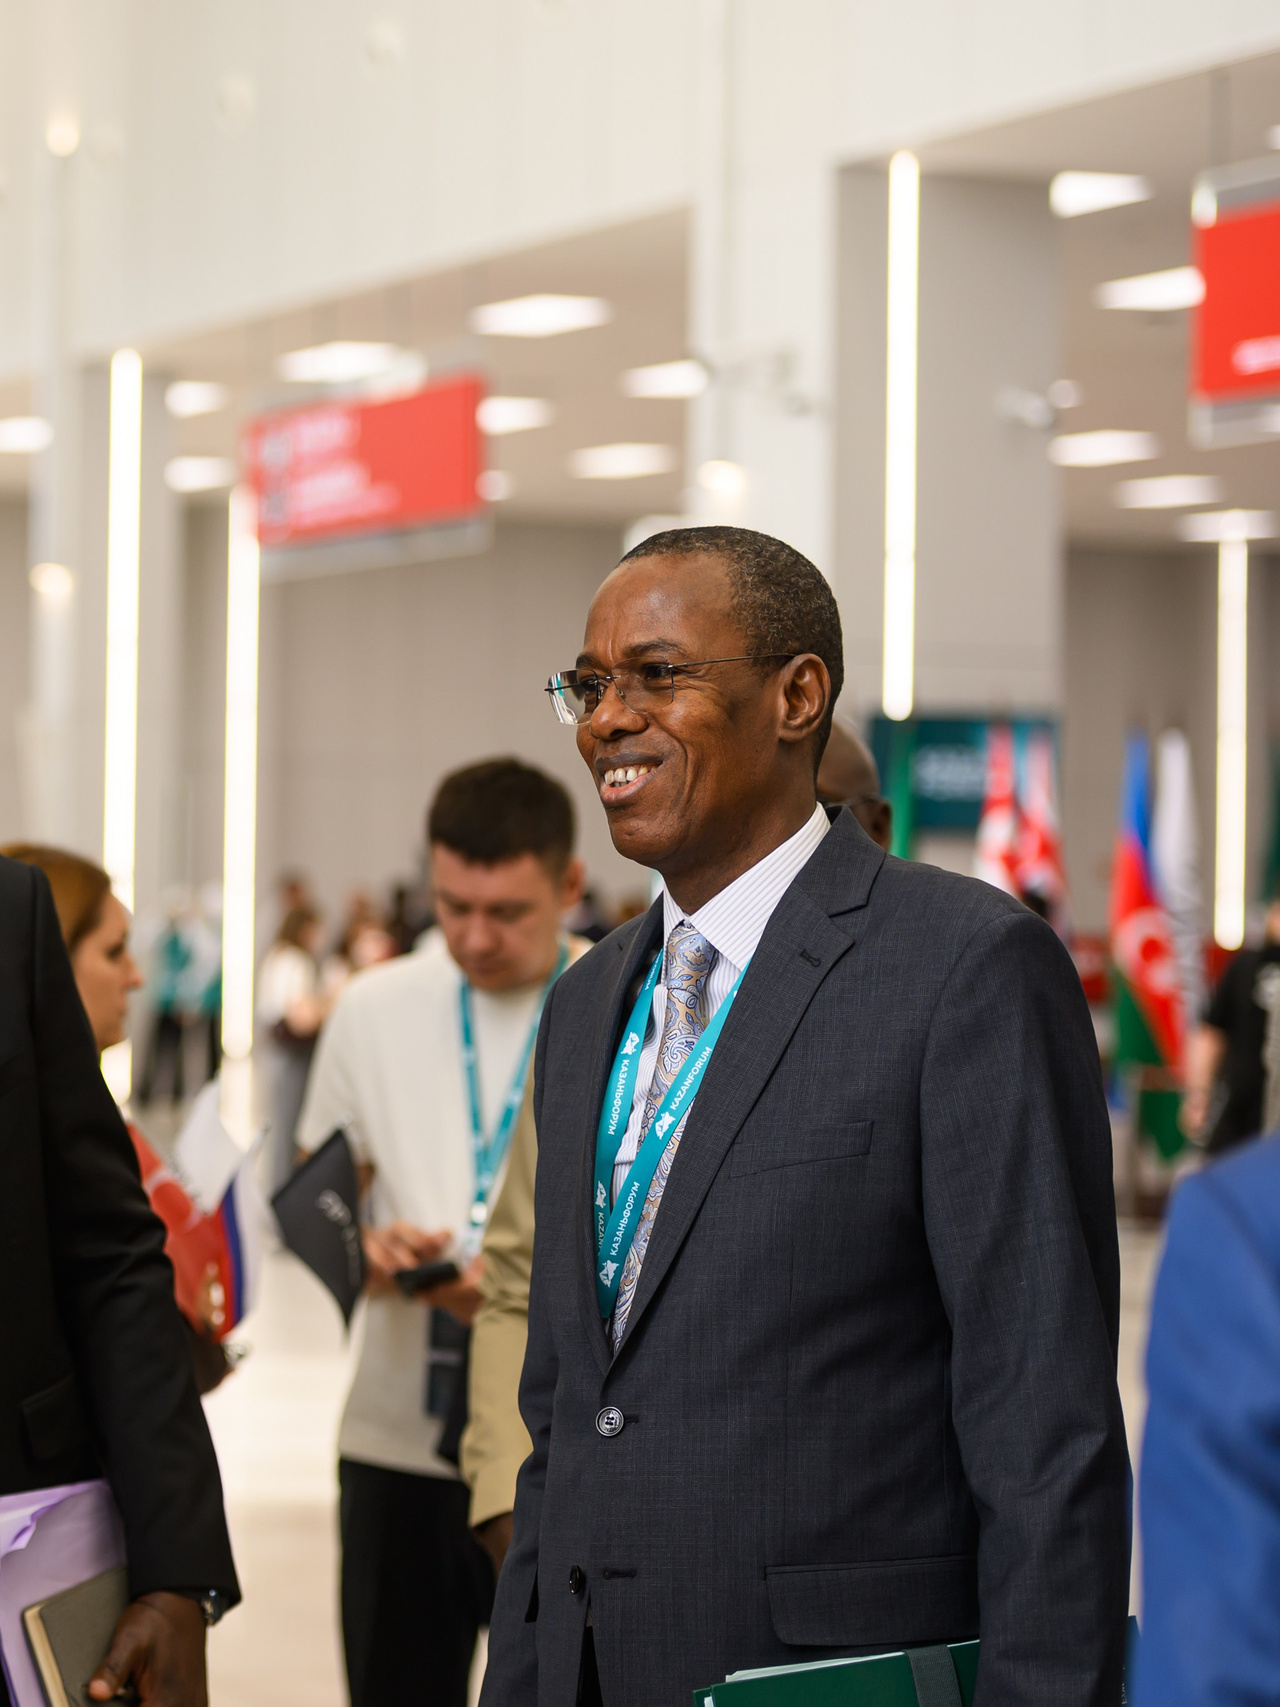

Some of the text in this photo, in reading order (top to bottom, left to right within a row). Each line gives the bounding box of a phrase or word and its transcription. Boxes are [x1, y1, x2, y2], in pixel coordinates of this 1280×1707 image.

[607, 1059, 630, 1136] КАЗАНЬФОРУМ
[669, 1046, 713, 1111] KAZANFORUM
[609, 1181, 641, 1256] КАЗАНЬФОРУМ
